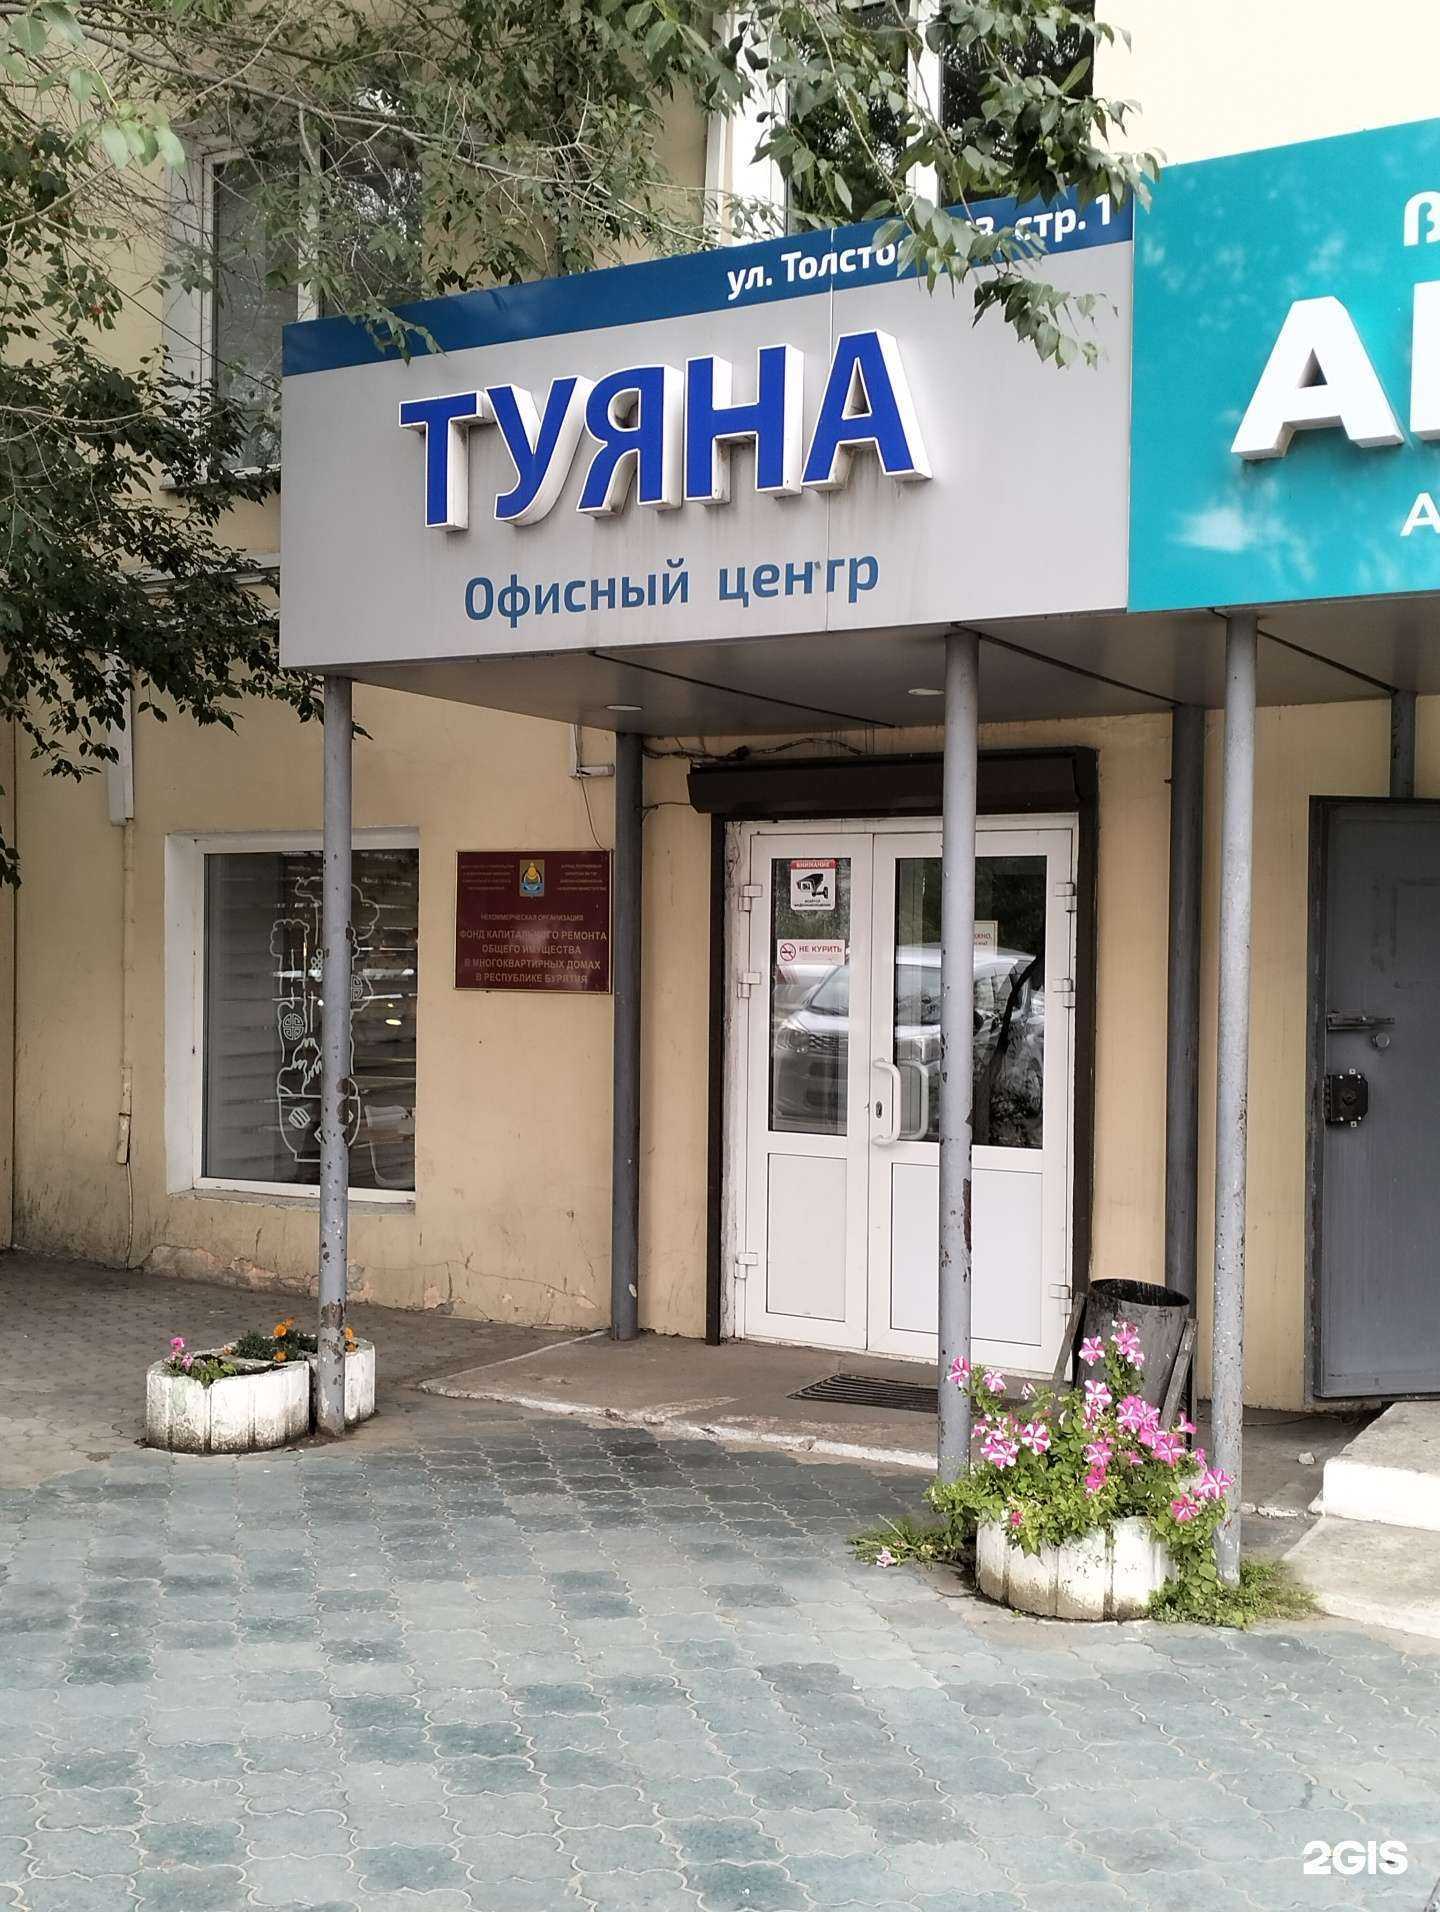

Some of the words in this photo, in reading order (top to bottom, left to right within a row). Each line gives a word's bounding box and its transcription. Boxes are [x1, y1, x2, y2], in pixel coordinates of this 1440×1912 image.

[727, 265, 773, 301] ул.
[781, 240, 904, 283] Толсто
[1014, 207, 1087, 243] стр.
[1095, 193, 1111, 226] 1
[400, 329, 933, 532] ТУЯНА
[464, 558, 689, 628] Офисный
[719, 555, 880, 609] центр
[460, 929, 484, 939] ФОНД
[561, 930, 607, 940] РЕМОНТА
[482, 944, 520, 953] ОБЩЕГО
[812, 945, 842, 953] КУРИТЬ
[472, 959, 565, 968] МНОГОКВАРТИРНЫХ
[566, 960, 600, 970] ДОМАХ
[484, 973, 543, 983] РЕСПУБЛИКЕ
